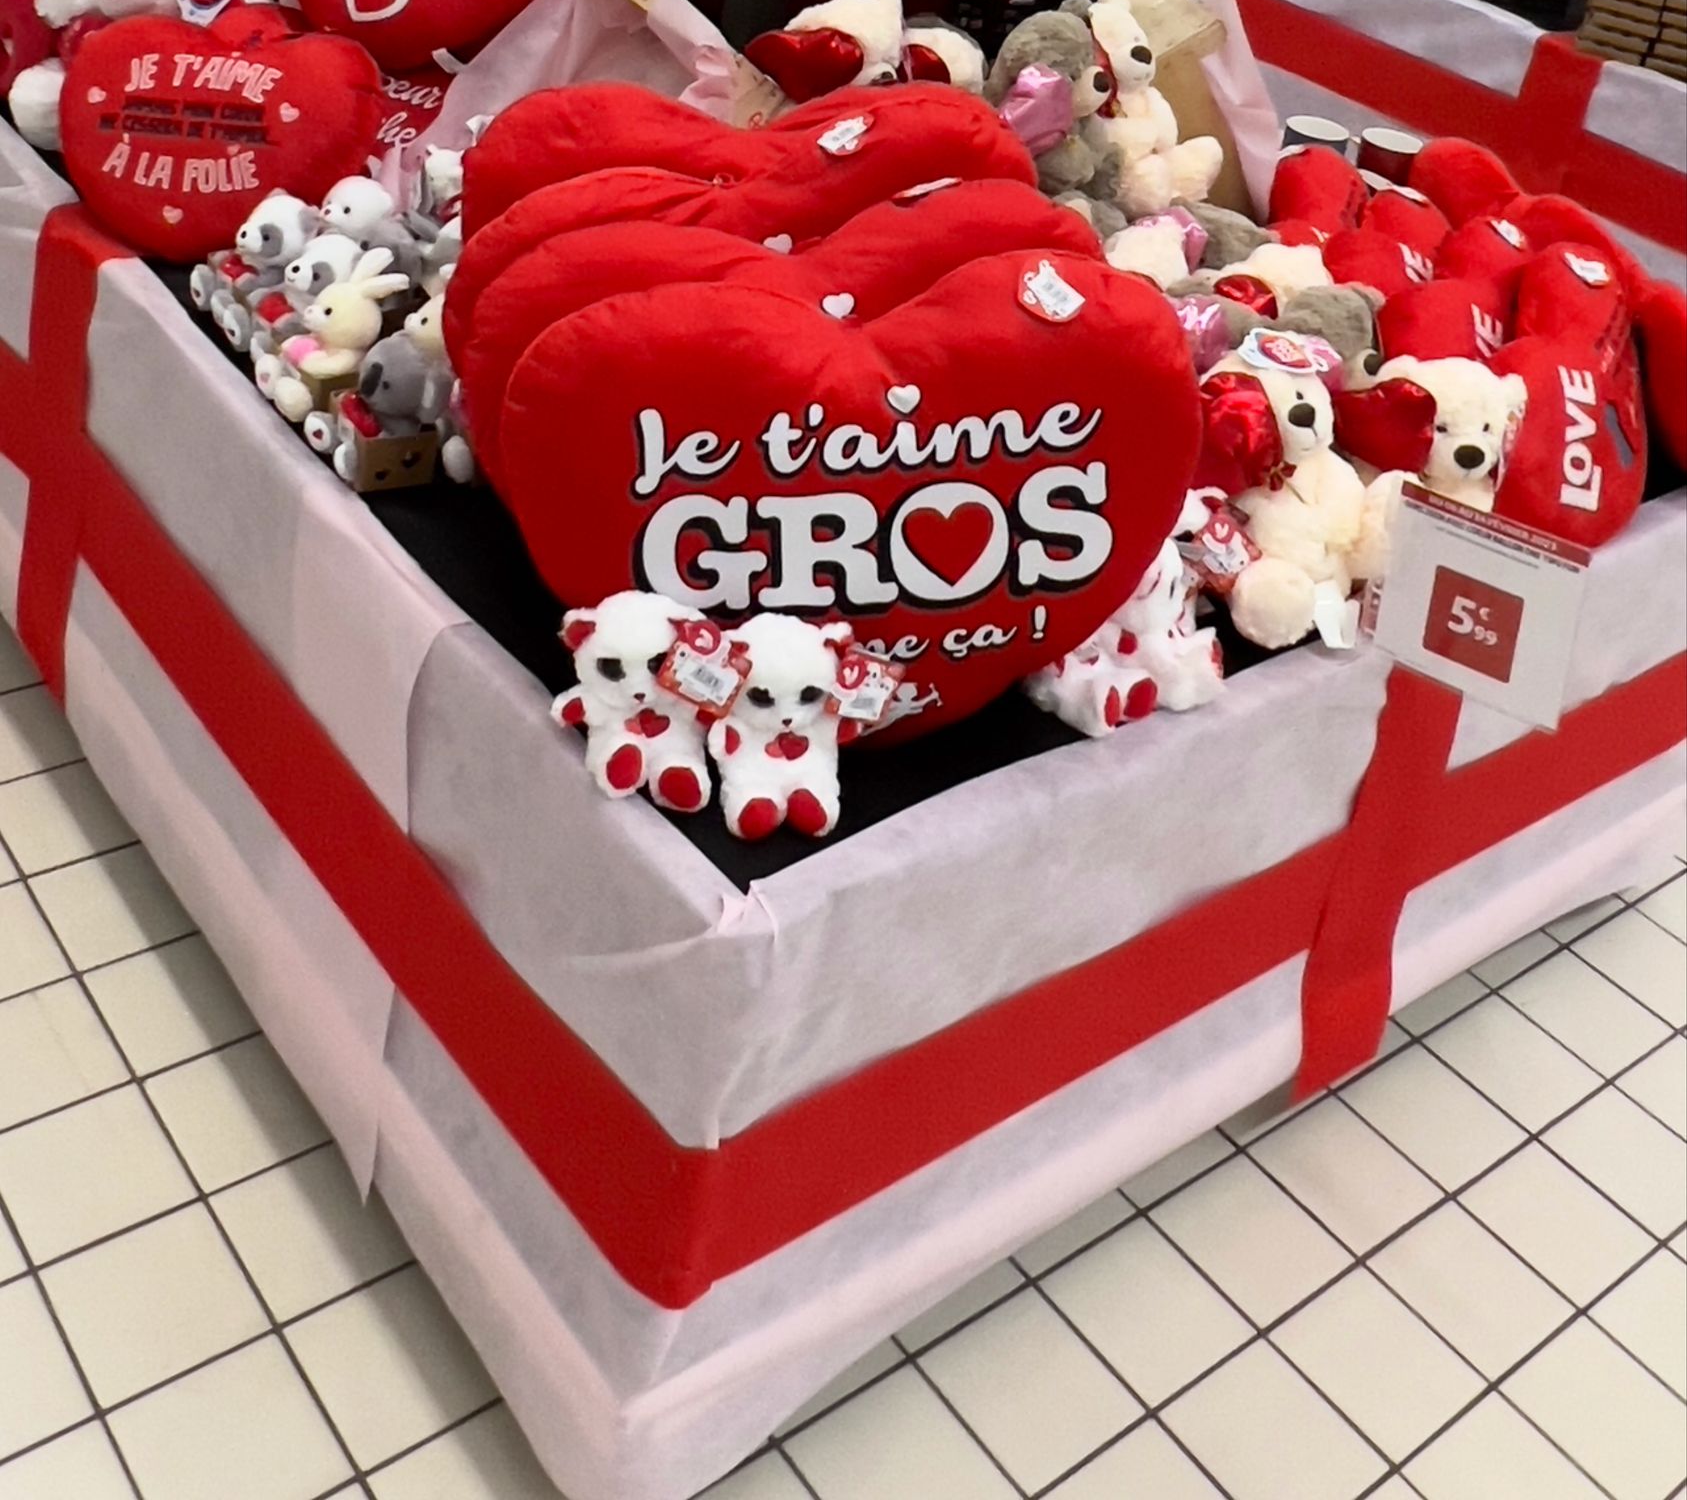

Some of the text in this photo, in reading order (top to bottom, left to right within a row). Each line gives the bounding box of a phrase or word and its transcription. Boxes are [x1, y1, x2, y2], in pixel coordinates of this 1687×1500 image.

[124, 51, 284, 104] JE T'AIME
[102, 132, 260, 194] À LA FOLIE
[634, 385, 1102, 495] Je t'aime
[1558, 365, 1602, 512] LOVE
[641, 462, 1114, 611] GROS
[943, 624, 1018, 658] ça
